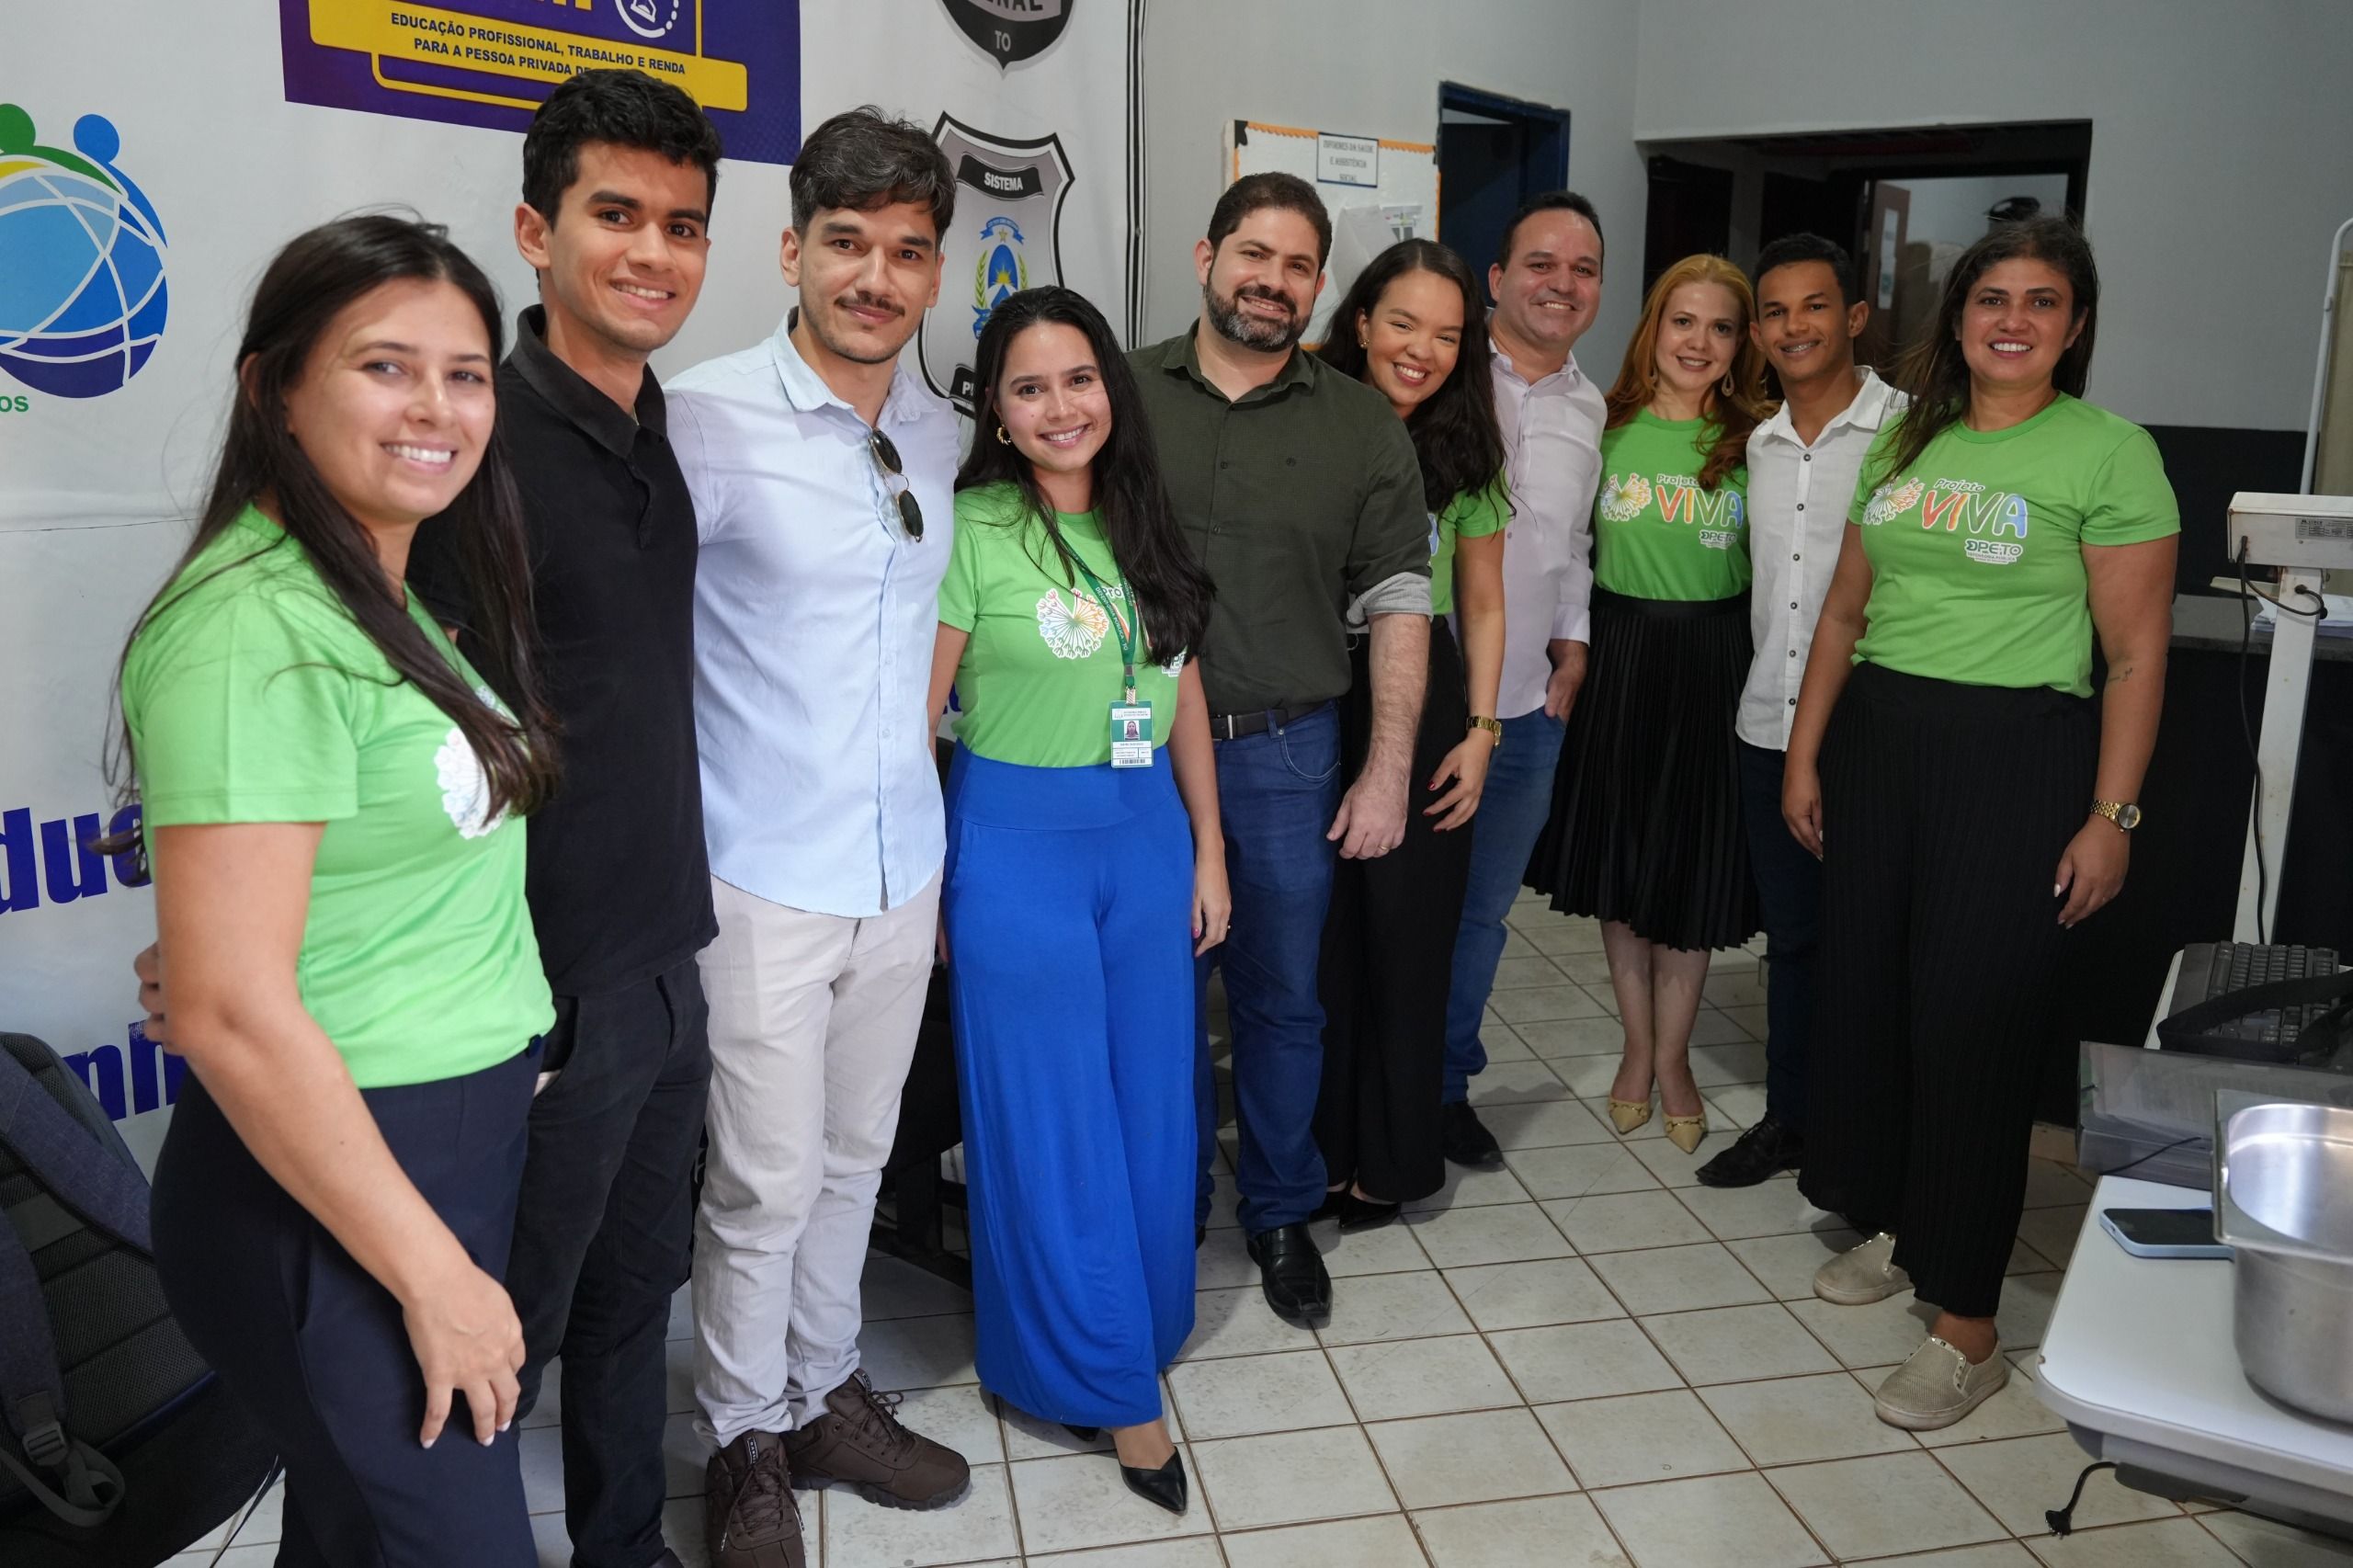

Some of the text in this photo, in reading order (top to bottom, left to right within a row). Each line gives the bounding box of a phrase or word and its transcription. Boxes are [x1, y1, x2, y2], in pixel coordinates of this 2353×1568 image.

[391, 12, 686, 74] EDUCAÇÃO PROFISSIONAL, TRABALHO E RENDA
[414, 38, 449, 55] PARA
[452, 44, 461, 57] A
[465, 47, 516, 66] PESSOA
[518, 56, 572, 75] PRIVADA
[995, 29, 1011, 52] TO
[983, 172, 1024, 191] SISTEMA
[1934, 479, 1984, 492] Projeto
[1655, 485, 1743, 528] VIVA
[1922, 490, 2028, 538] VIVA
